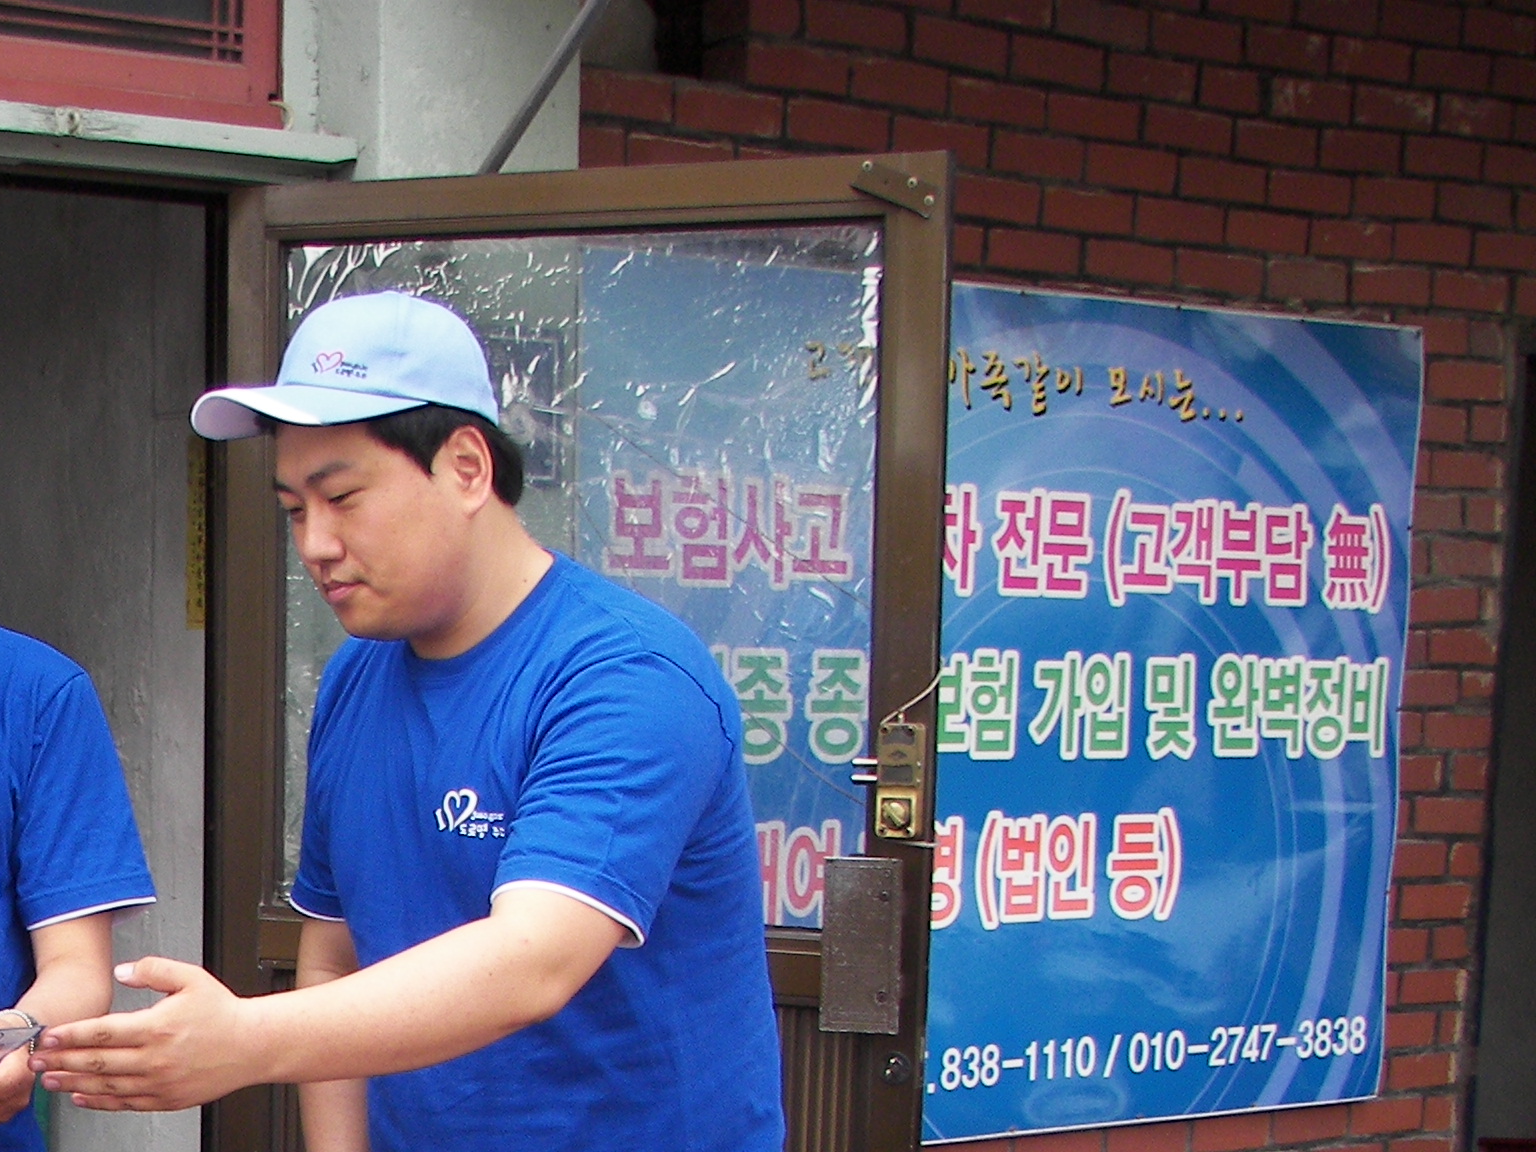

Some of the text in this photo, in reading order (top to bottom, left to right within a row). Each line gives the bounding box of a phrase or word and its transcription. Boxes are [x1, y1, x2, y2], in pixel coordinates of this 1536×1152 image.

[606, 472, 852, 587] 보험사고
[993, 491, 1092, 596] 전문
[1106, 490, 1311, 606] (고객부담
[1322, 507, 1389, 612] 無)
[1032, 652, 1130, 759] 가입
[1147, 652, 1199, 758] 및
[1209, 650, 1388, 757] 완벽정비
[978, 811, 1094, 928] (법인
[1108, 809, 1182, 919] 등)
[1129, 1015, 1367, 1076] 010-2747-3838
